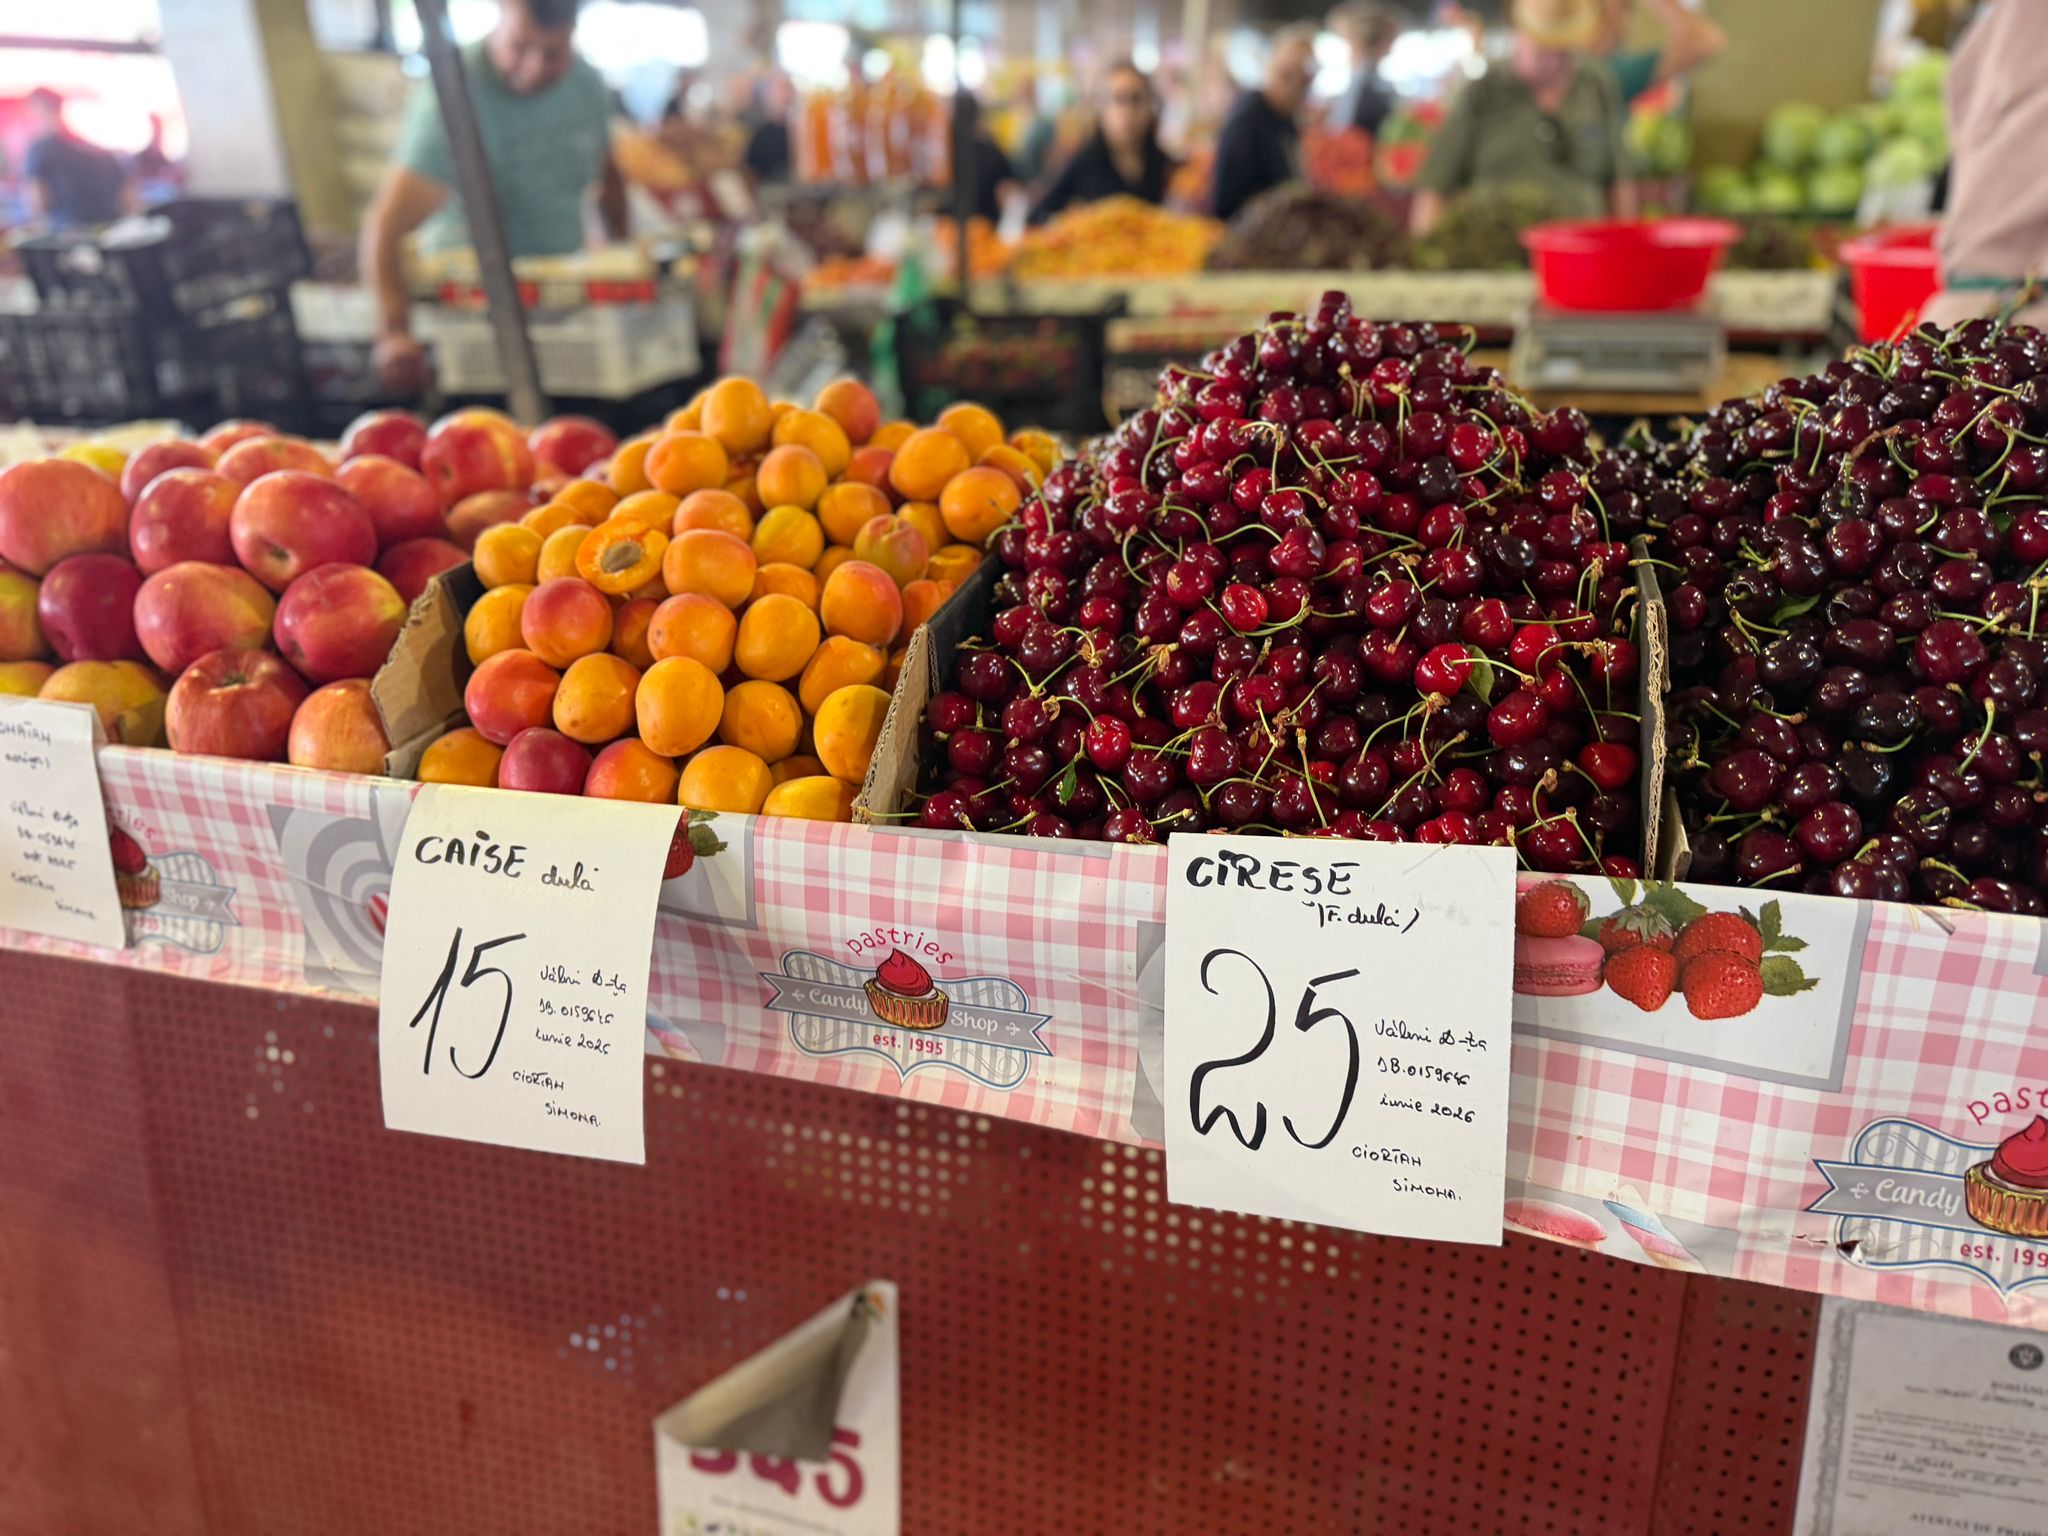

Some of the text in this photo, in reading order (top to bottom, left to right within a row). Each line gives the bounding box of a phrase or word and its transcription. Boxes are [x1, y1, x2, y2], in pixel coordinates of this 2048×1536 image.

[845, 926, 954, 965] pastries
[409, 926, 527, 1079] 15
[808, 988, 998, 1036] Candy Shop
[873, 1033, 943, 1055] est. 1995
[1189, 947, 1361, 1151] 25
[1431, 1103, 1476, 1124] 2026
[1875, 1178, 1963, 1216] Candy
[1960, 1243, 2000, 1262] est.
